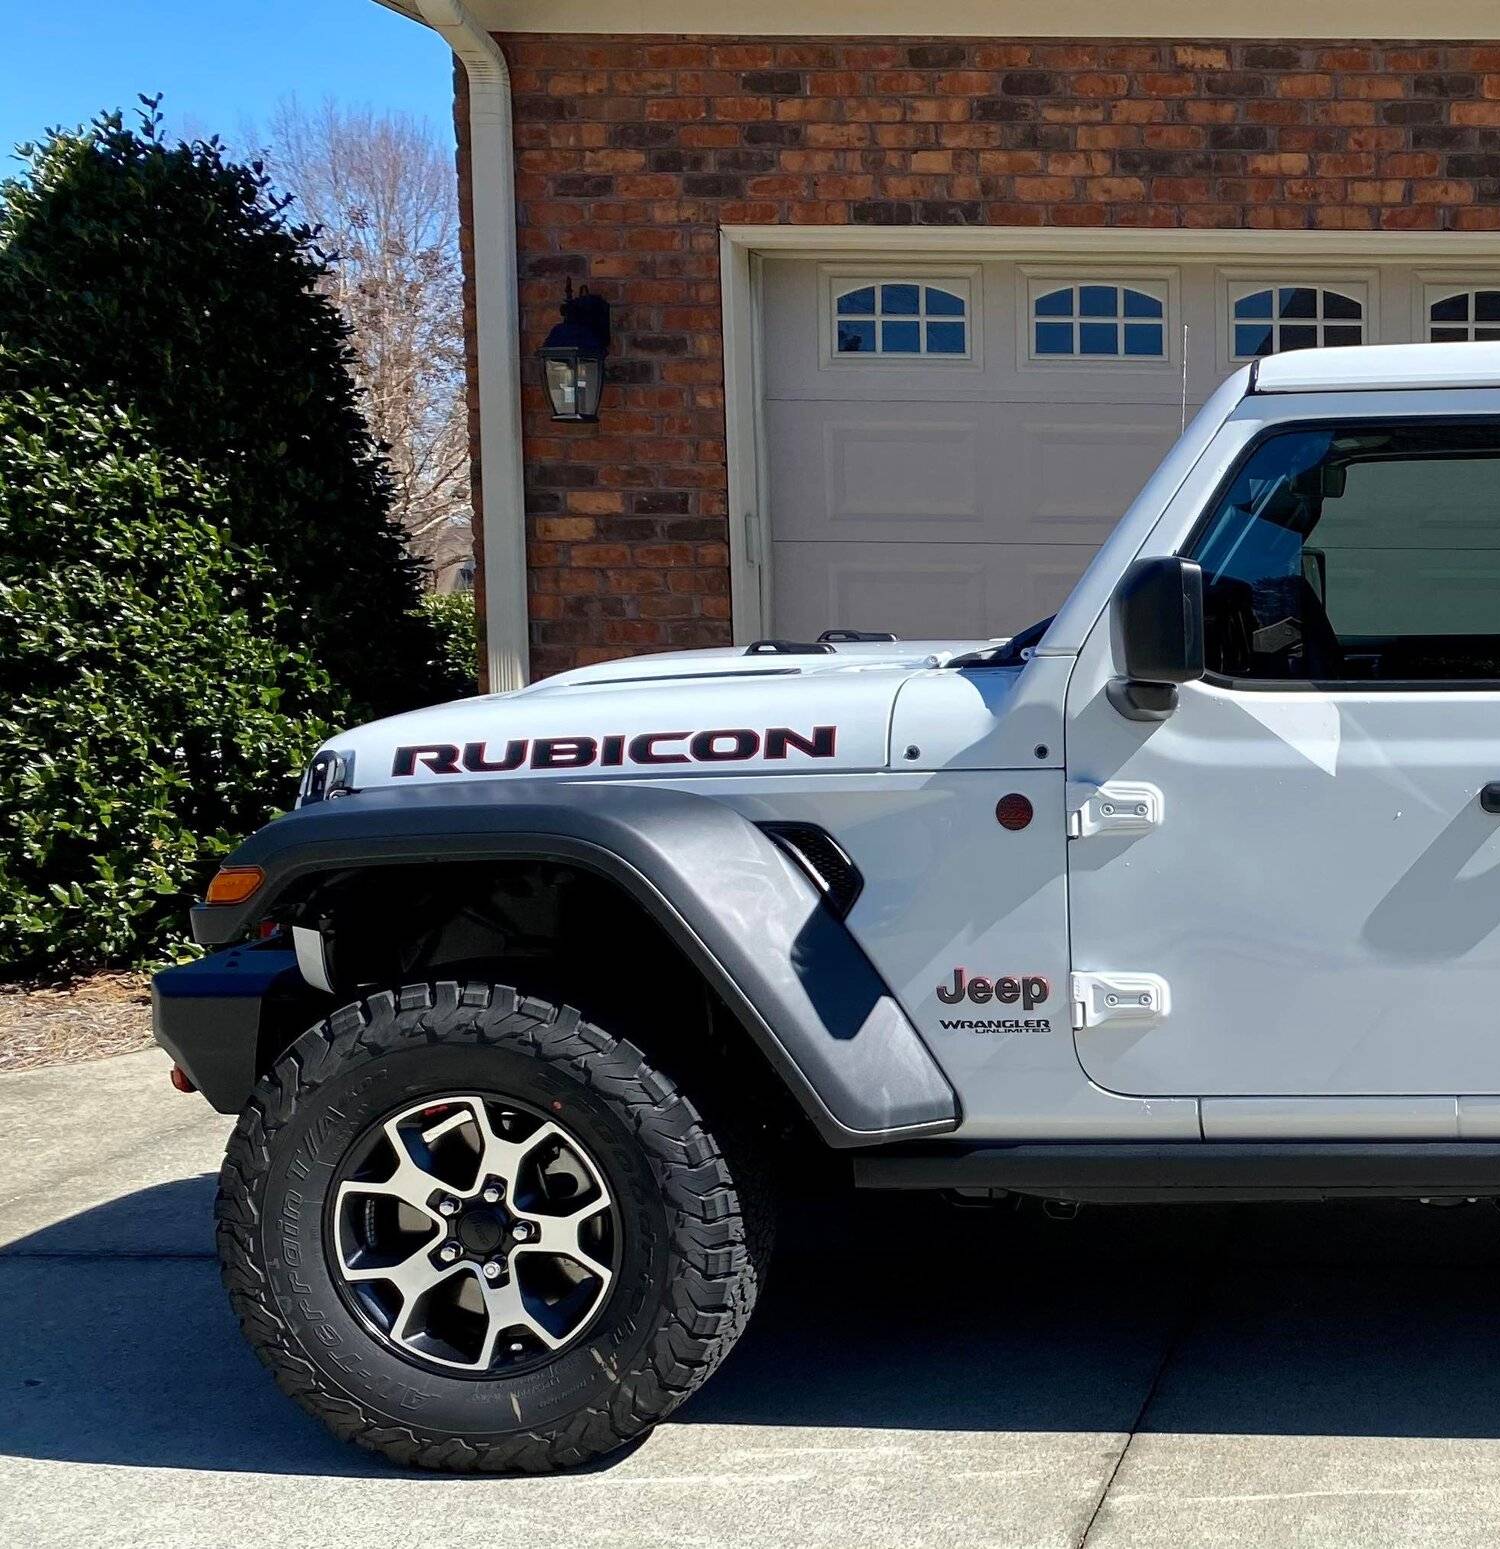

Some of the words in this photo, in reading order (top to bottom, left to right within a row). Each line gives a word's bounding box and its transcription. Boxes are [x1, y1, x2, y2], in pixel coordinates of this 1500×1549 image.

[391, 725, 838, 777] RUBICON
[936, 967, 1050, 1010] Jeep
[939, 1019, 1050, 1030] WRANGLER
